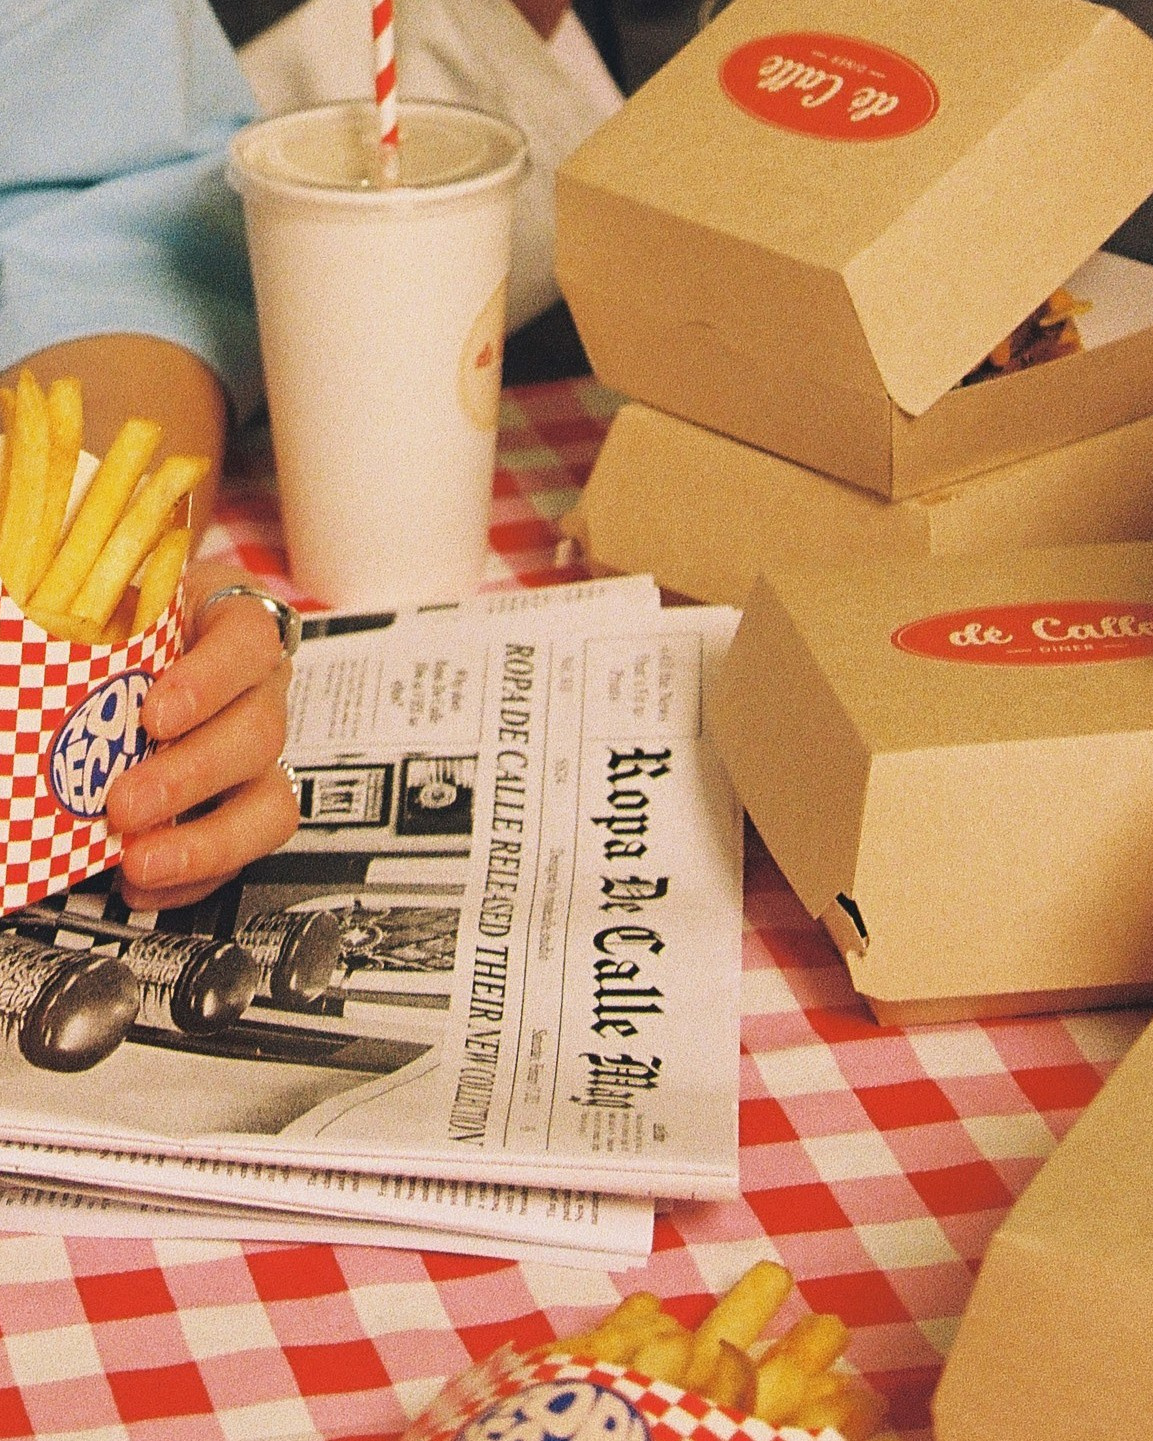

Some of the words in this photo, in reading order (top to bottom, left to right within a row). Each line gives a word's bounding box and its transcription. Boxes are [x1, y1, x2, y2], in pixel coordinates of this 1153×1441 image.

[757, 55, 844, 108] Calle
[848, 86, 899, 122] de
[949, 622, 1013, 646] de
[501, 643, 534, 703] ROPA
[55, 674, 153, 755] ROP
[498, 709, 529, 744] DE
[491, 750, 527, 832] CALLE
[590, 748, 671, 863] Ropa
[478, 839, 521, 938] RELEASED
[598, 876, 668, 913] De
[468, 946, 509, 1022] THEIR
[589, 926, 664, 1038] Calle
[463, 1024, 501, 1067] NEW
[447, 1068, 496, 1148] COLLECTION
[568, 1053, 661, 1109] Mag
